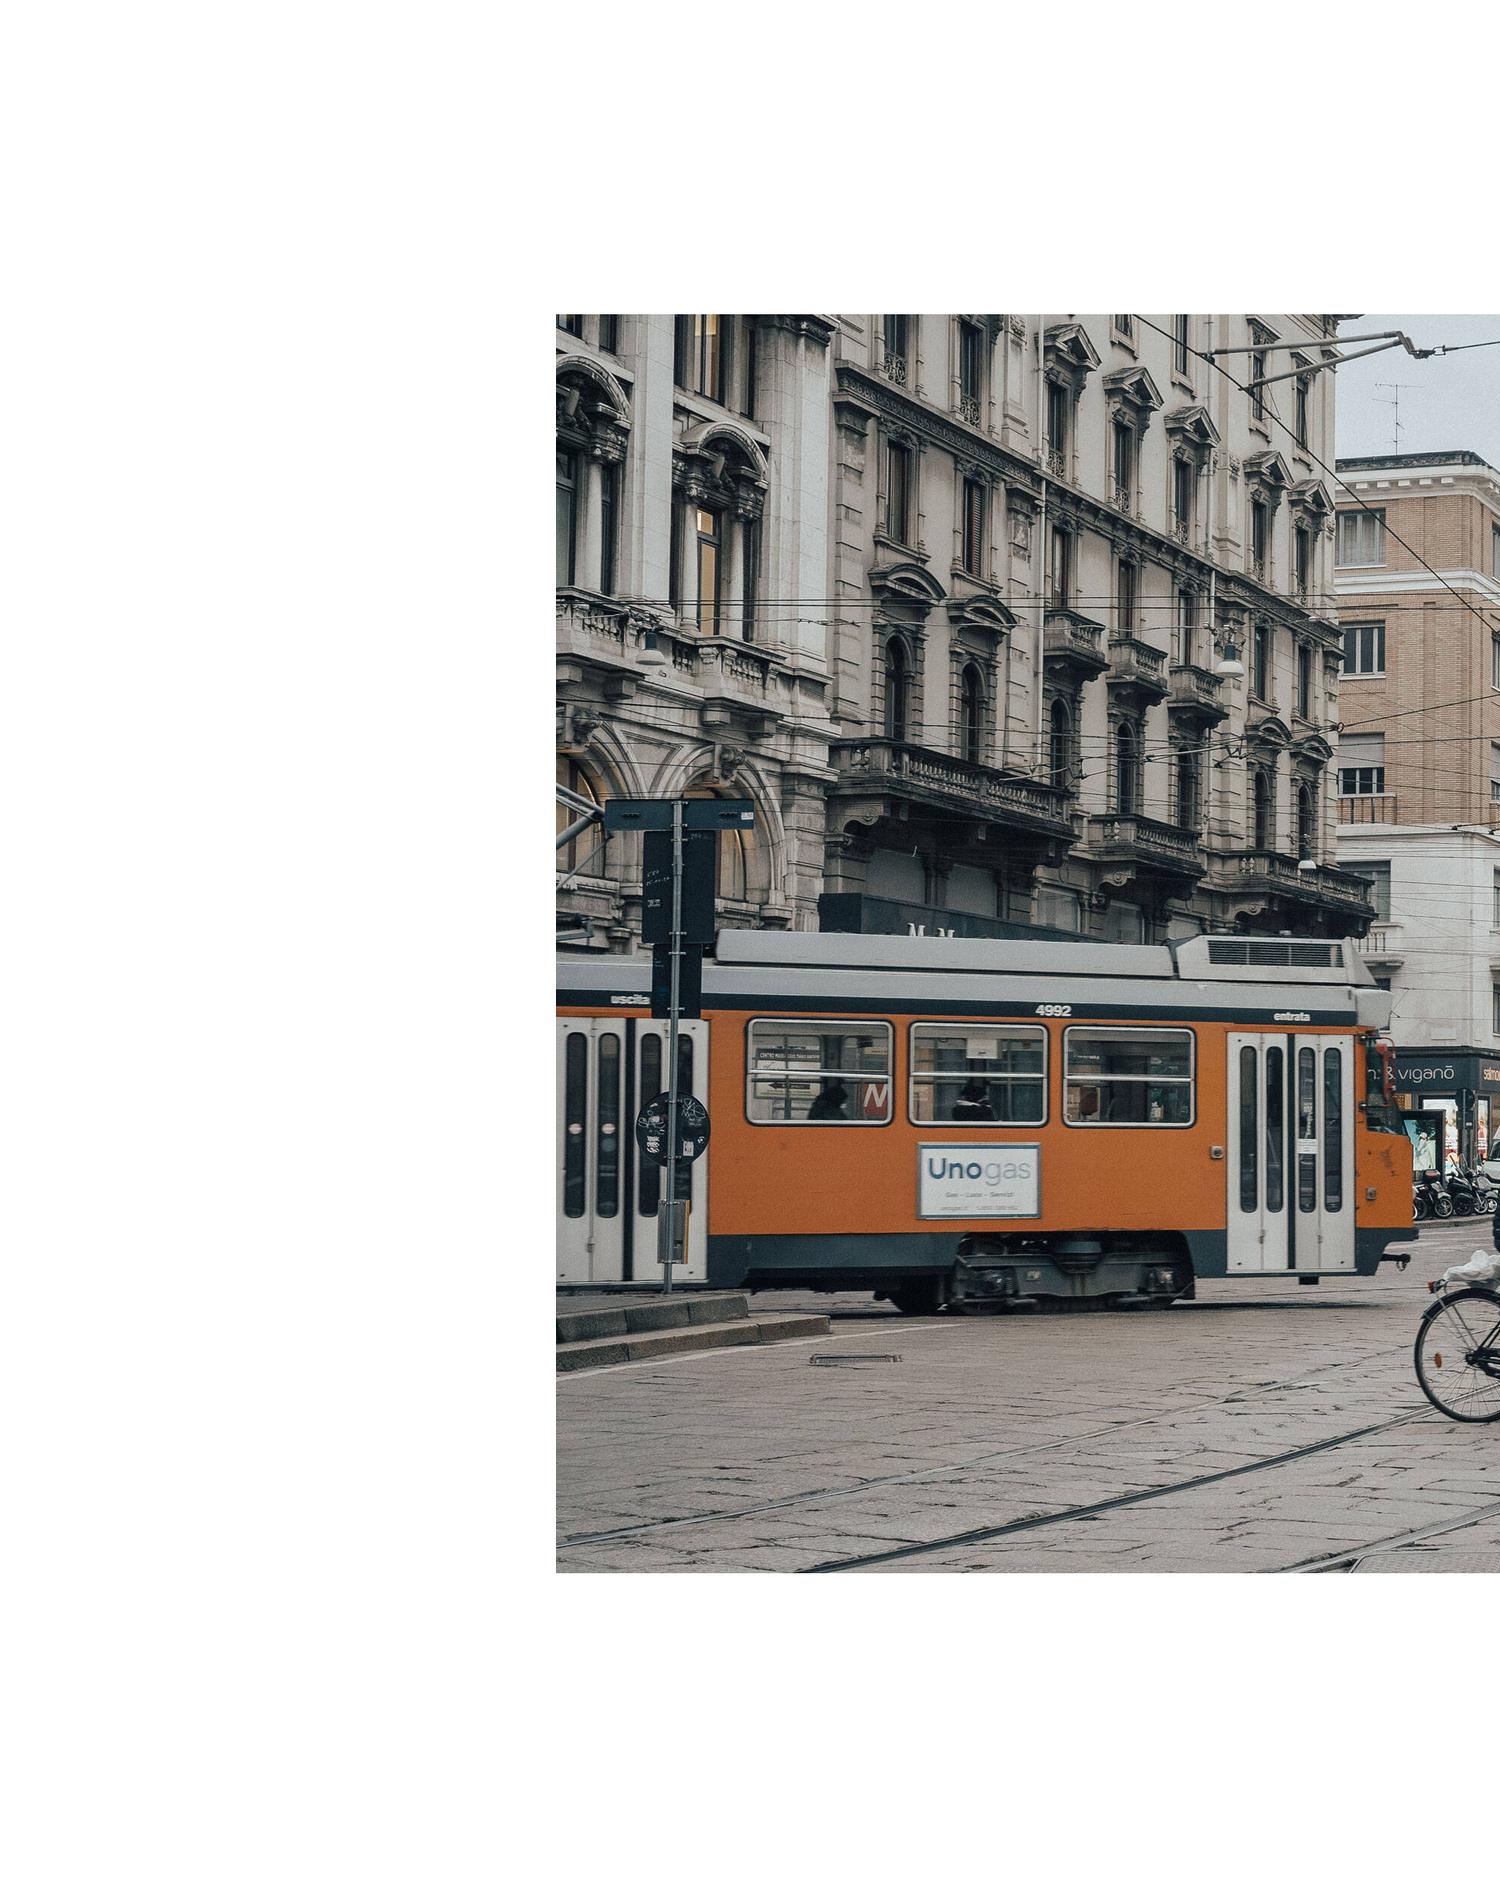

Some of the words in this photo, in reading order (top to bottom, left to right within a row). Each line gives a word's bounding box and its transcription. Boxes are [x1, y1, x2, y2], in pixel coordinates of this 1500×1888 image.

[611, 994, 650, 1004] uscita
[1035, 1004, 1072, 1016] 4992
[1273, 1012, 1311, 1021] entrata
[928, 1157, 1031, 1186] Unogas
